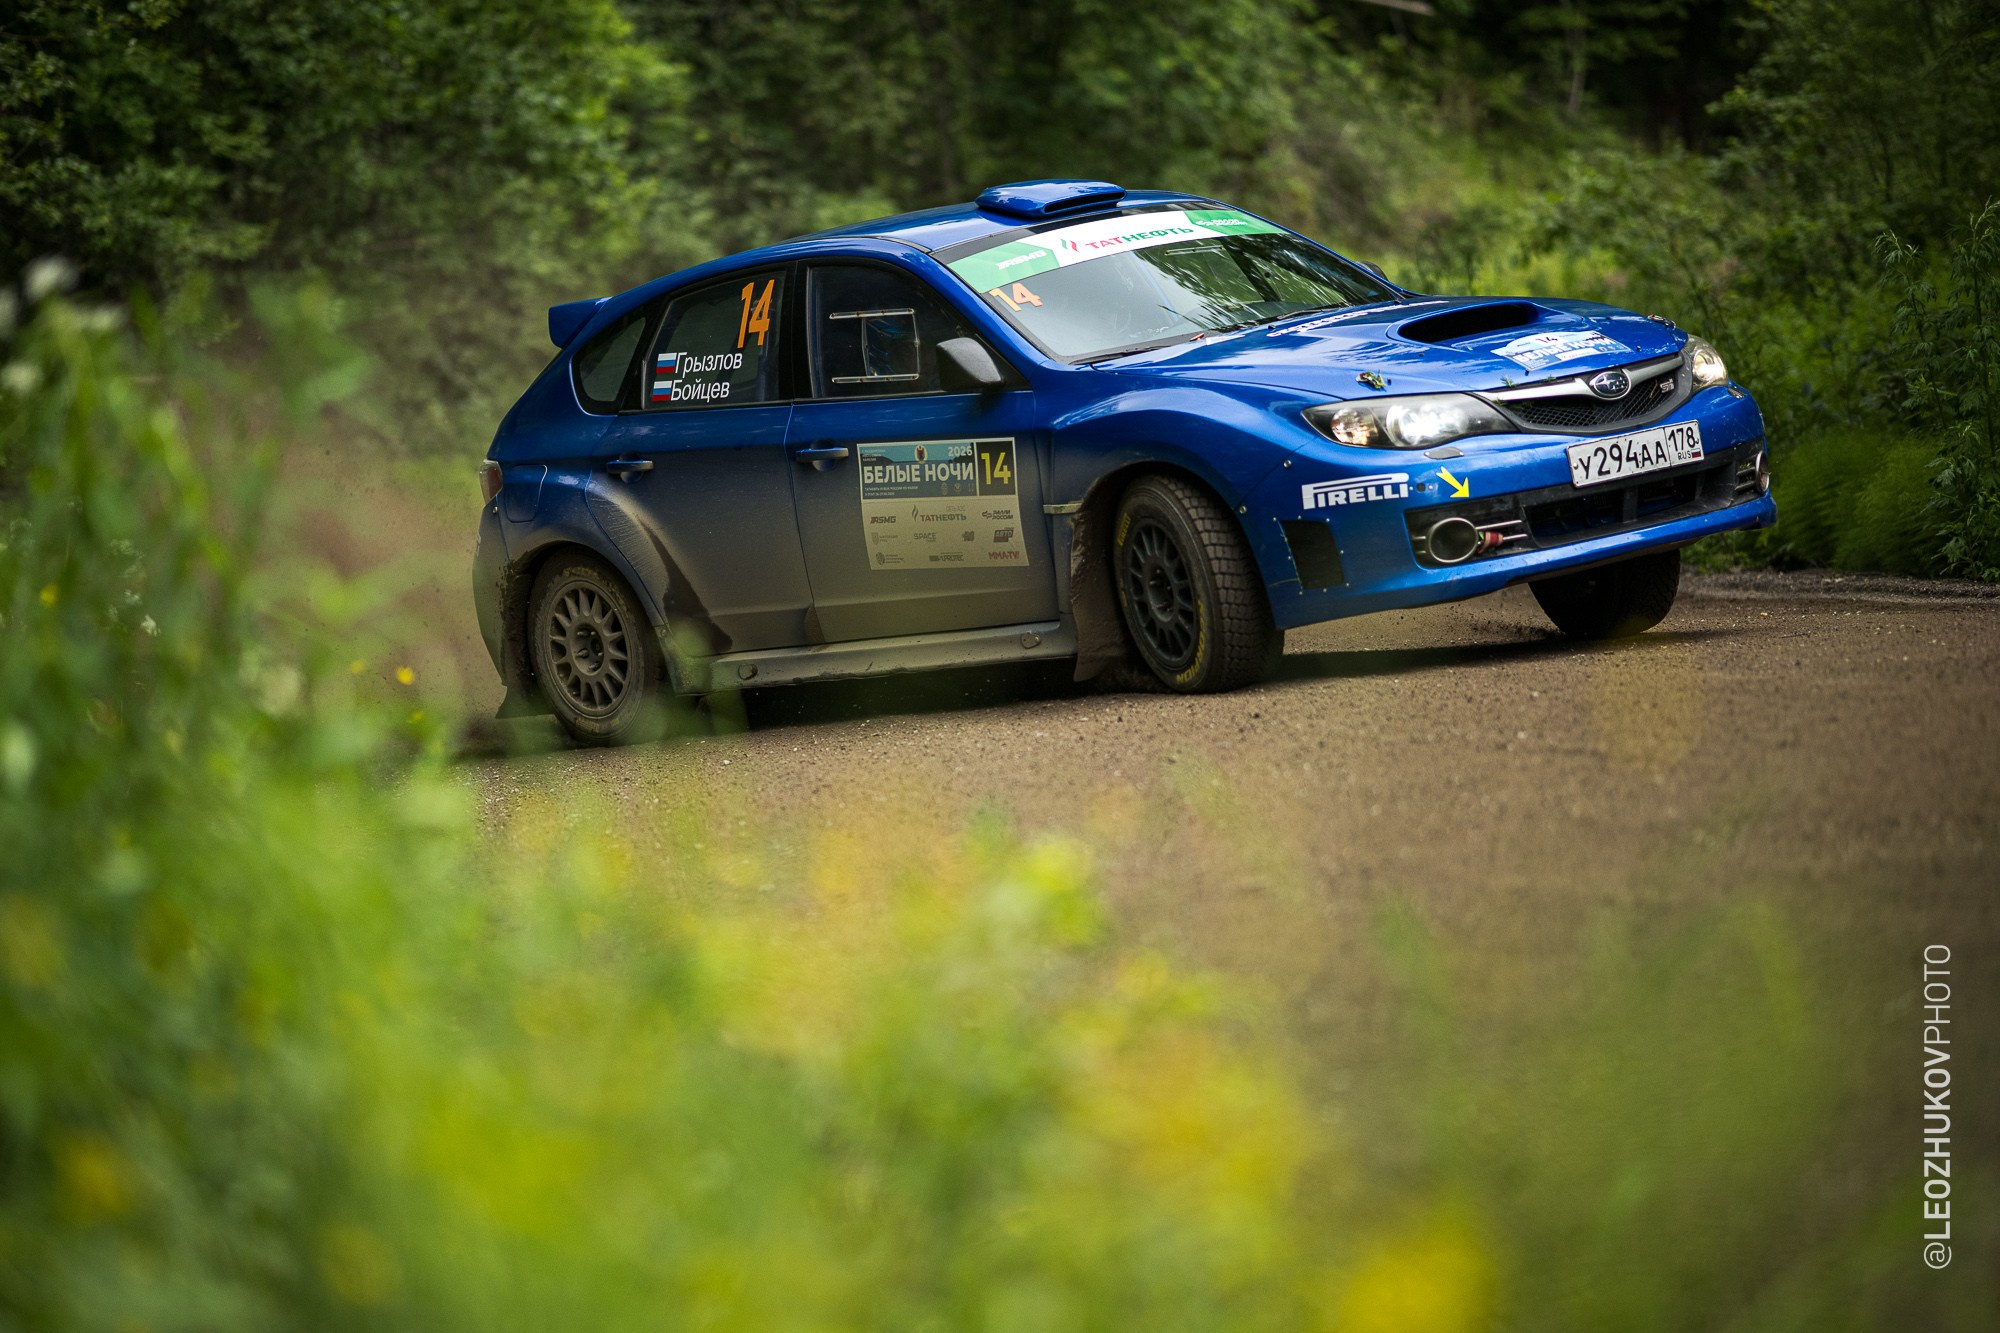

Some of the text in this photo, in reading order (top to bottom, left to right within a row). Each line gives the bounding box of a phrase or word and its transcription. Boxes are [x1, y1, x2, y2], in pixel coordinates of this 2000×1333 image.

[1085, 226, 1195, 250] ТАТНЕФТЬ
[988, 282, 1045, 312] 14
[737, 279, 775, 349] 14
[675, 351, 743, 379] Грызлов
[670, 378, 730, 403] Бойцев
[947, 446, 973, 458] 2026
[1668, 427, 1696, 452] 178
[1677, 451, 1692, 460] RUS
[863, 462, 974, 484] БЕЛЫЕ НОЧИ
[980, 452, 1011, 485] 14
[1301, 472, 1409, 510] PIRELLI
[919, 513, 967, 522] ТАТНЕФТЬ
[913, 532, 937, 540] SPACE
